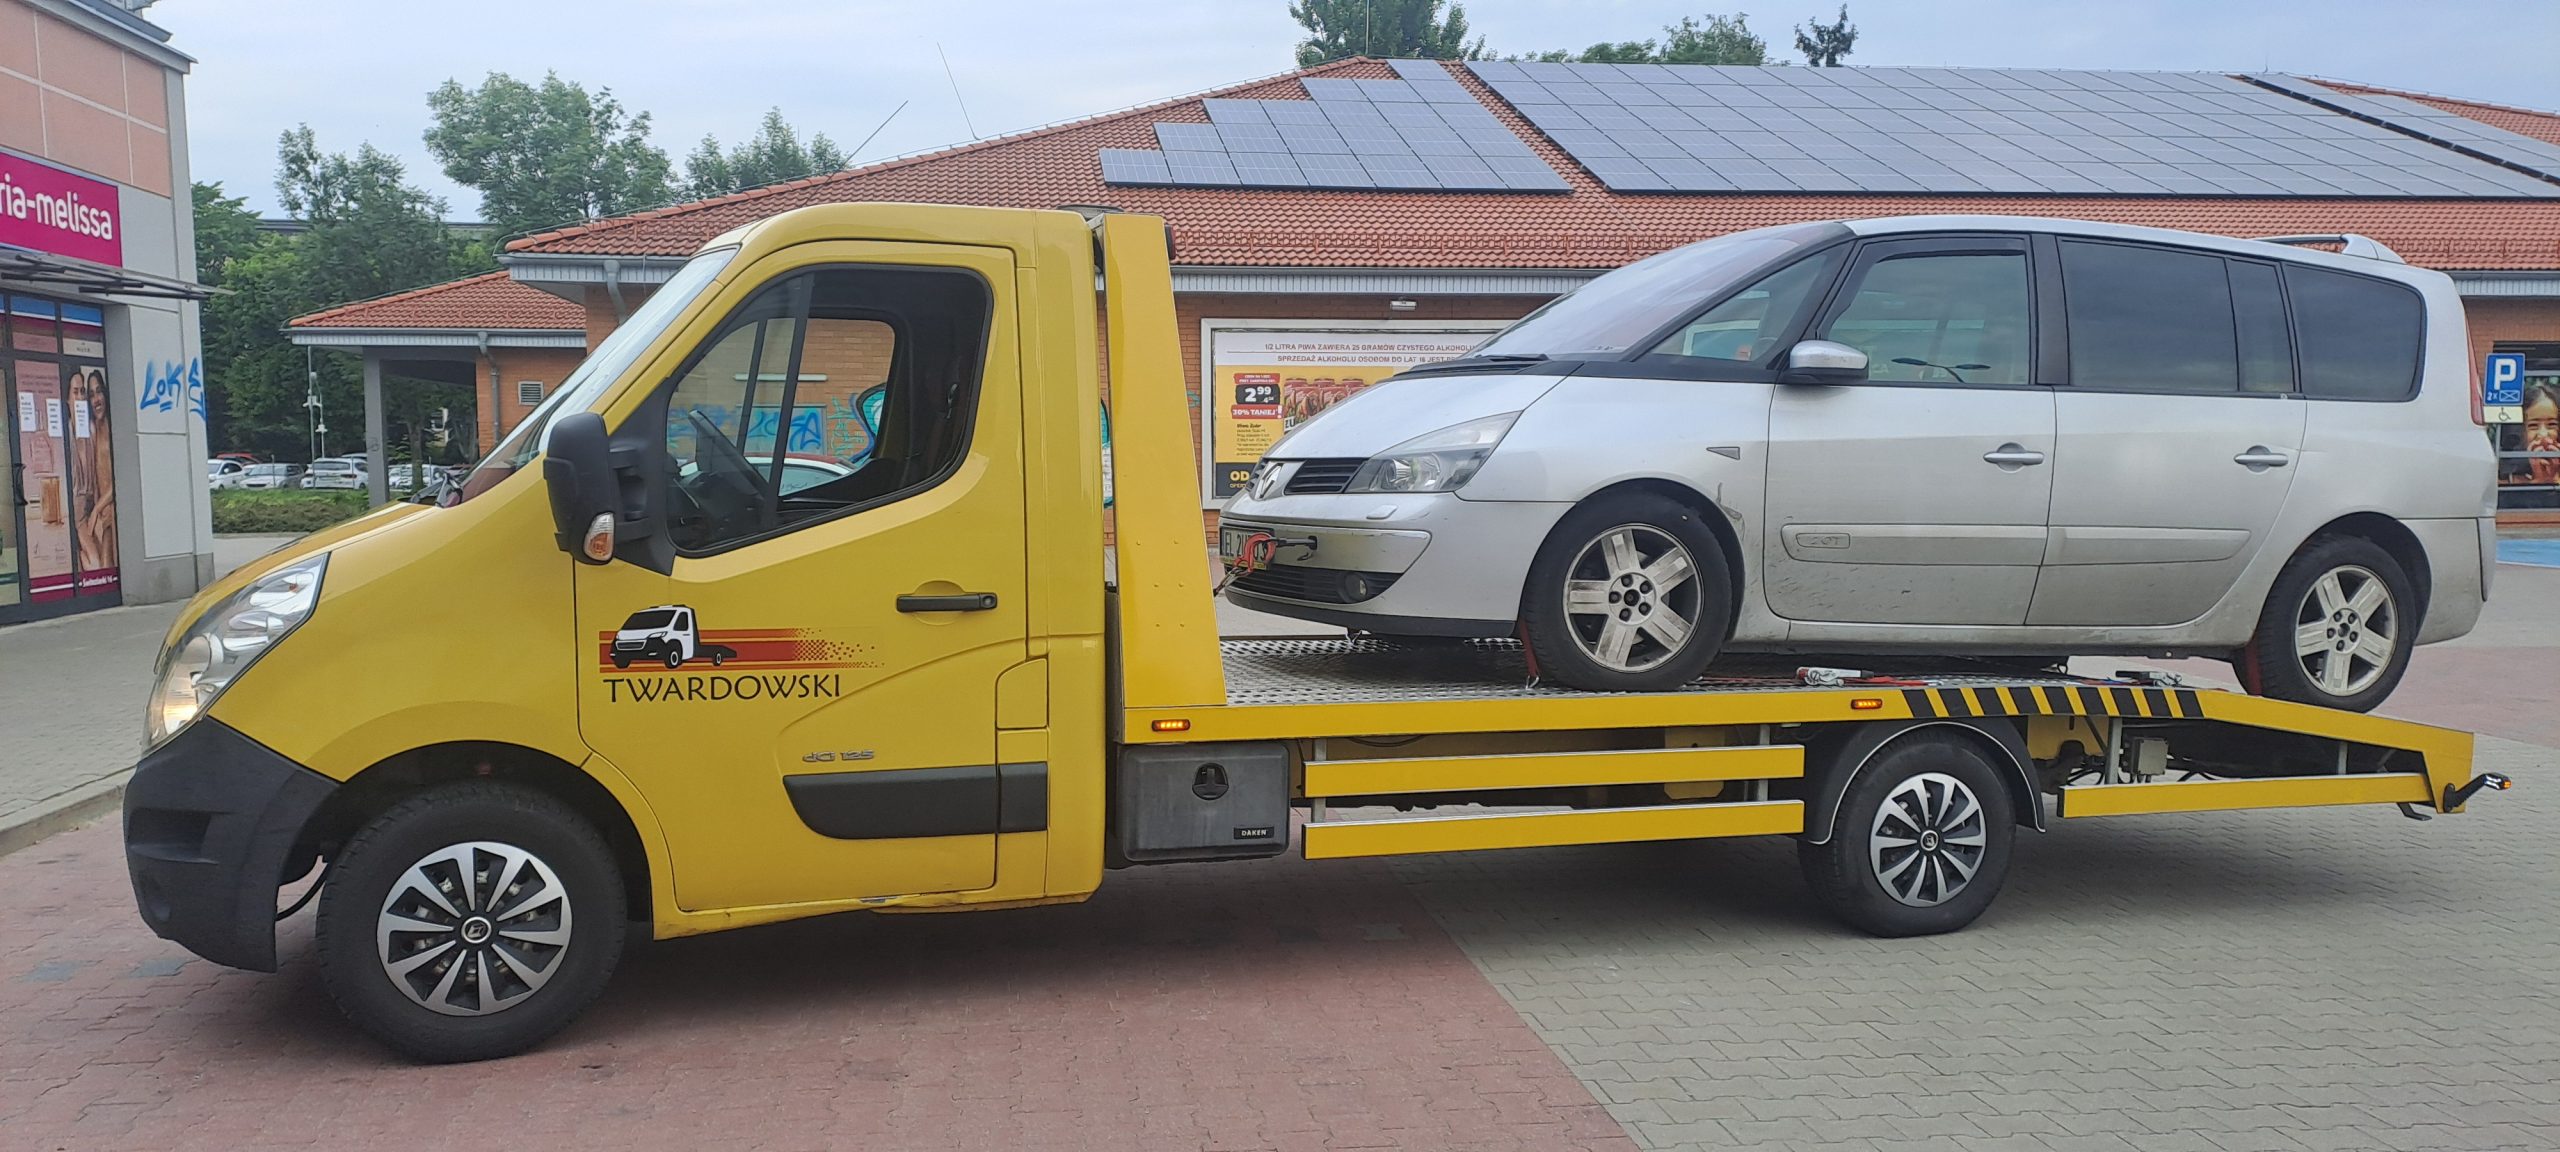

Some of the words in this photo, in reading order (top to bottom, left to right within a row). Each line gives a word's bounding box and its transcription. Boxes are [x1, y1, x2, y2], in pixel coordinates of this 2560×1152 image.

[1275, 343, 1297, 351] LITRA
[1317, 355, 1357, 363] ALKOHOLU
[2493, 358, 2517, 390] P
[603, 674, 840, 702] TWARDOWSKI
[840, 749, 875, 761] 125
[1241, 829, 1267, 837] DAKEN
